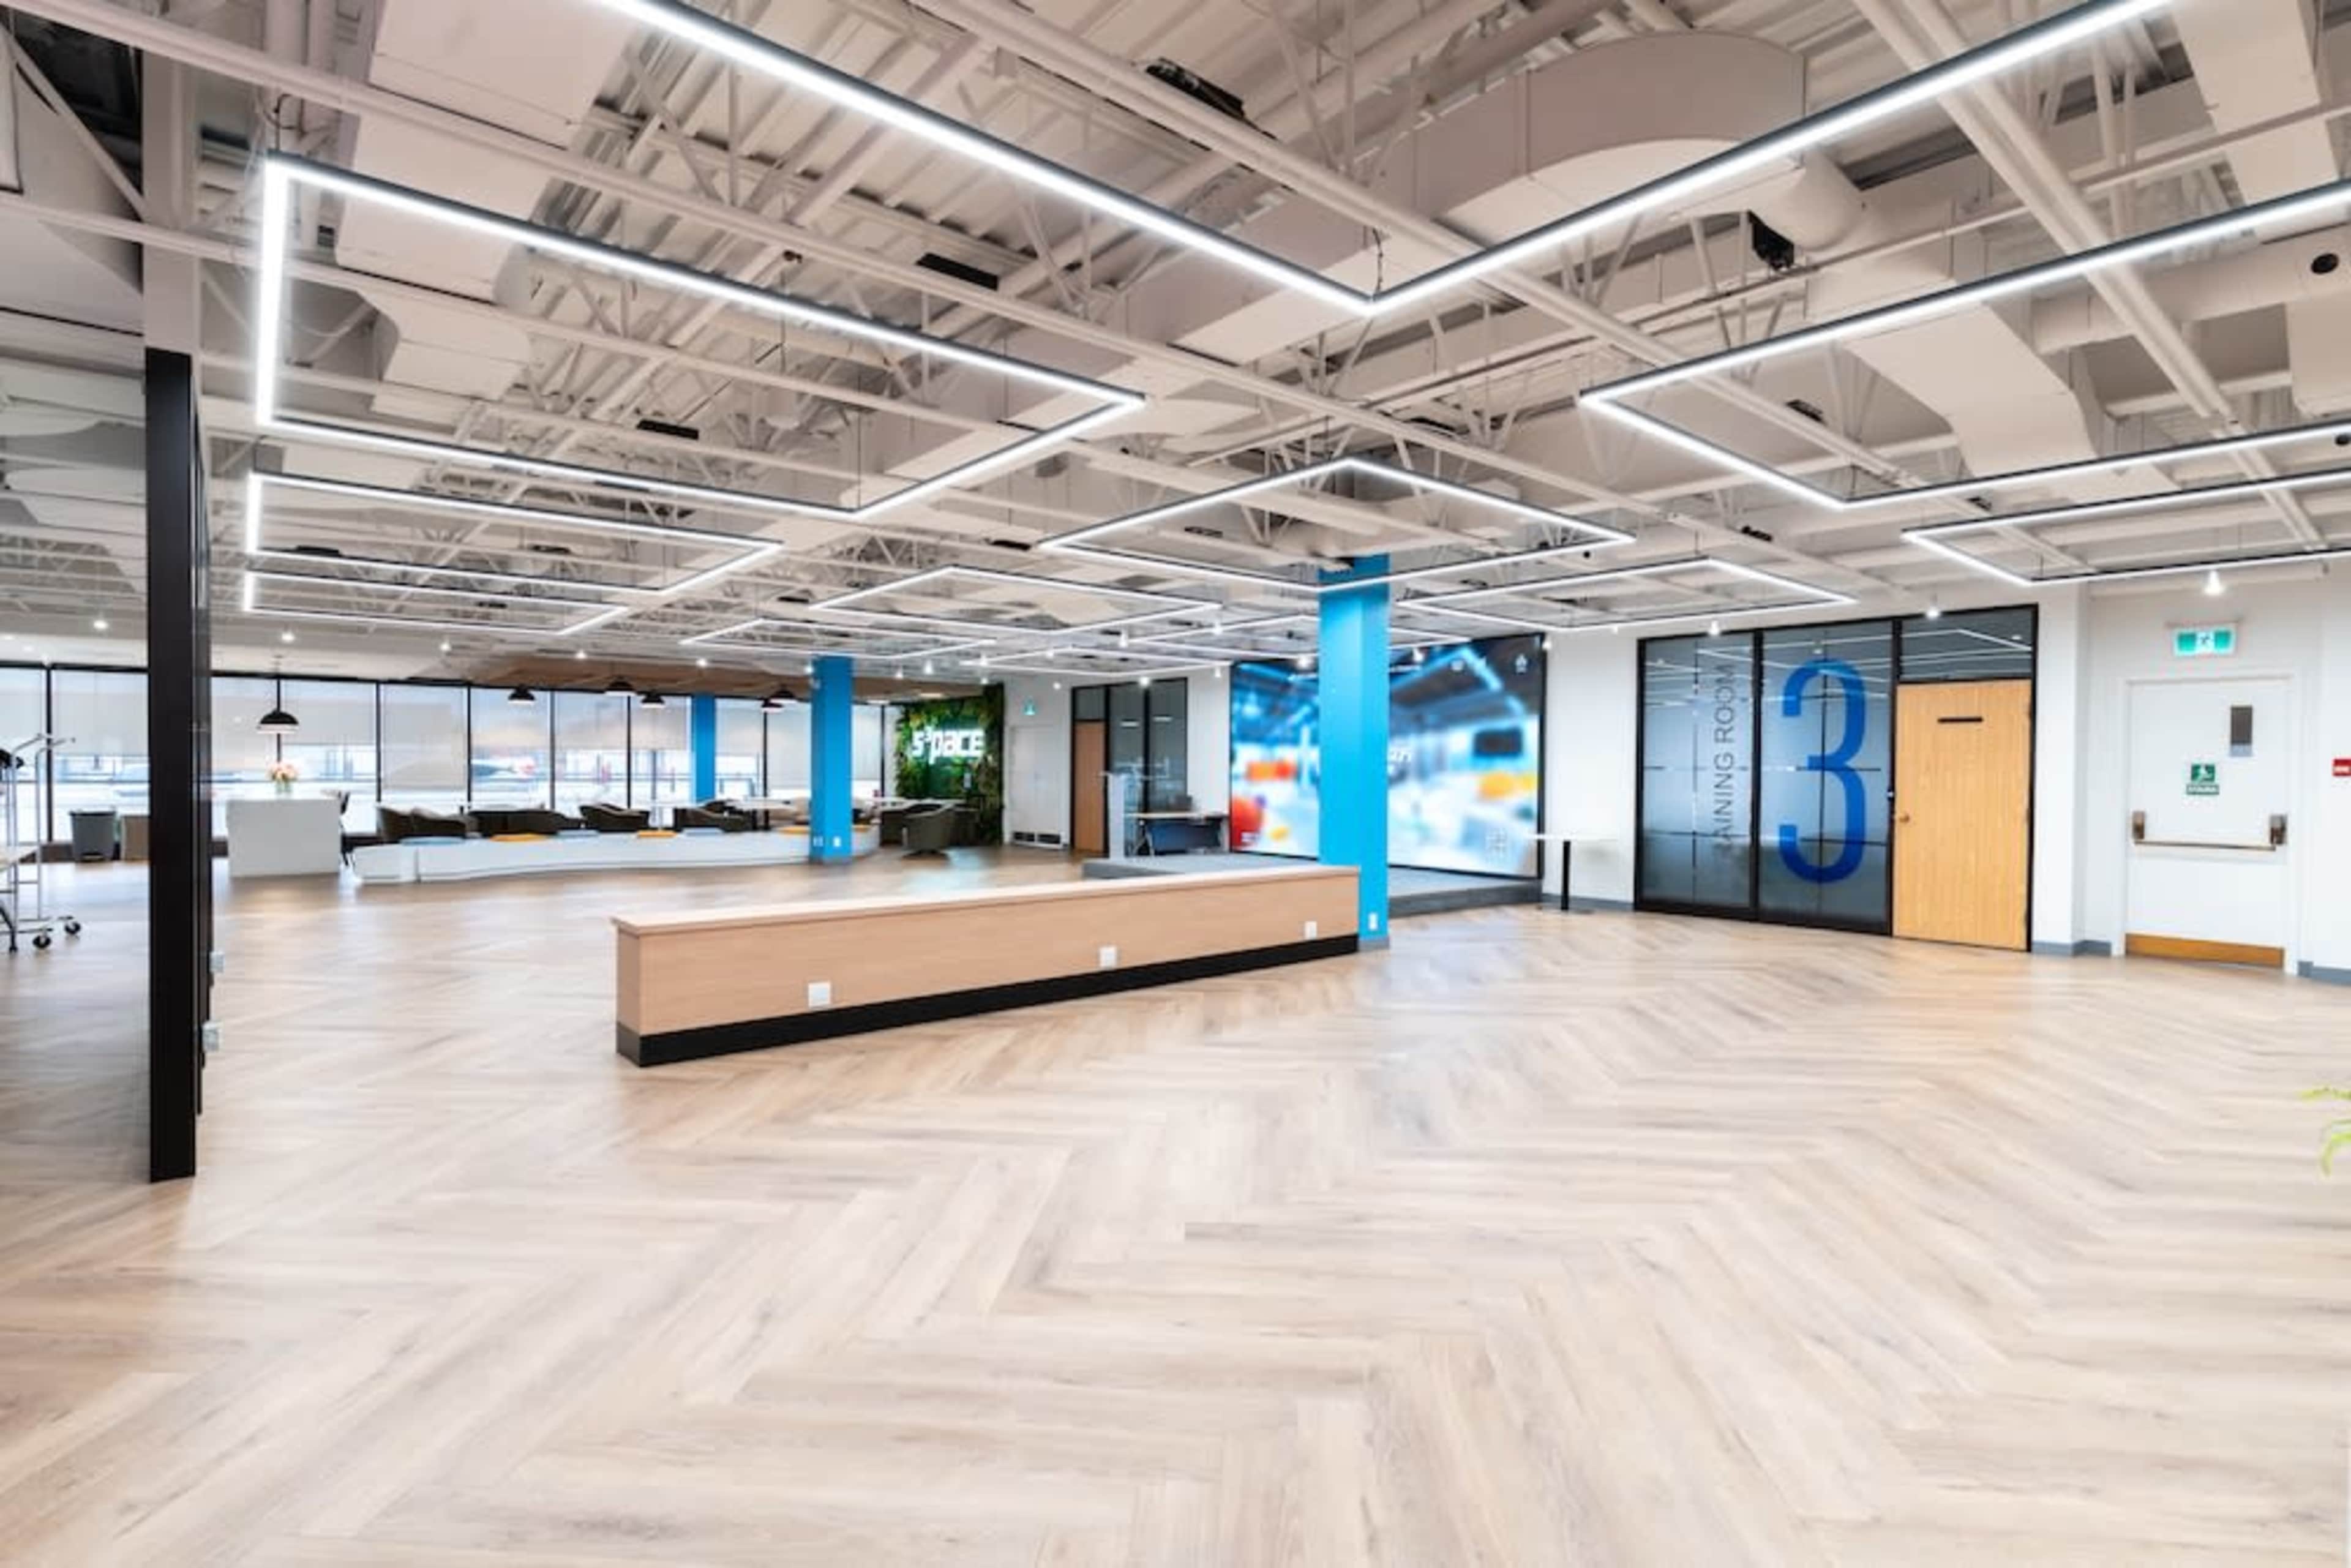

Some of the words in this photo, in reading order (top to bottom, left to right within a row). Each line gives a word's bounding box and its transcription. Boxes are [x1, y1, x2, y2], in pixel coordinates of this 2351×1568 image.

[1714, 665, 1734, 743] ROOM
[1714, 752, 1734, 857] AINING
[1778, 658, 1866, 884] 3
